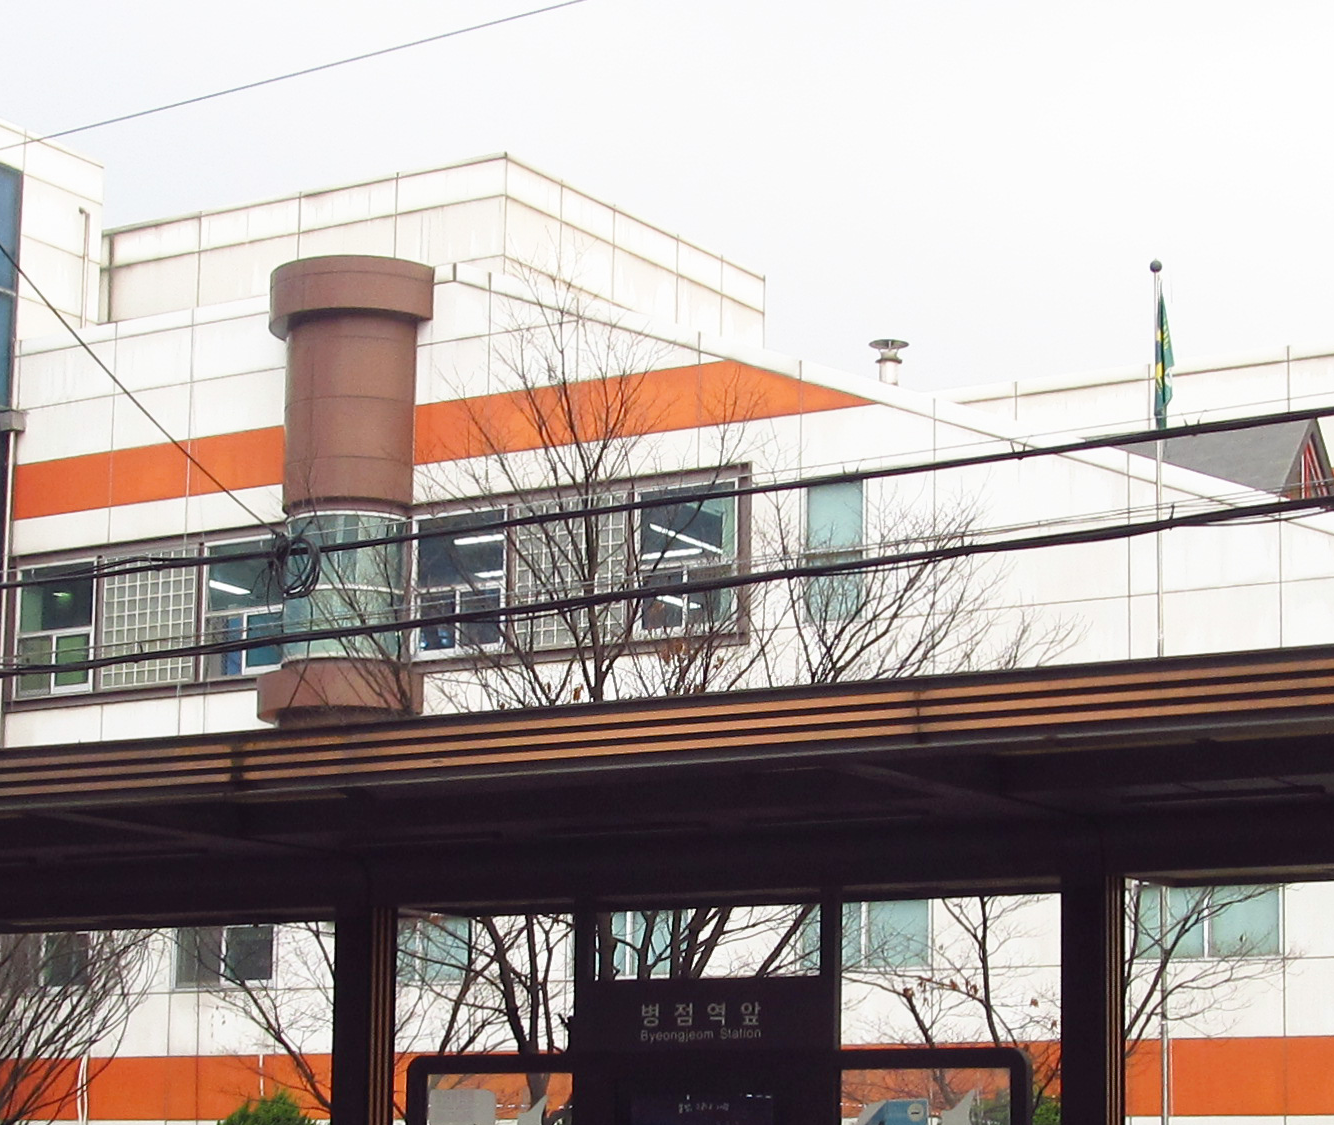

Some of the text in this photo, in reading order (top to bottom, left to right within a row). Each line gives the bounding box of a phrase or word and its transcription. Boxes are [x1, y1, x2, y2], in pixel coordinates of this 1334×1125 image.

[641, 1001, 762, 1027] 병점역앞
[640, 1027, 762, 1044] Byeongjeom Station
